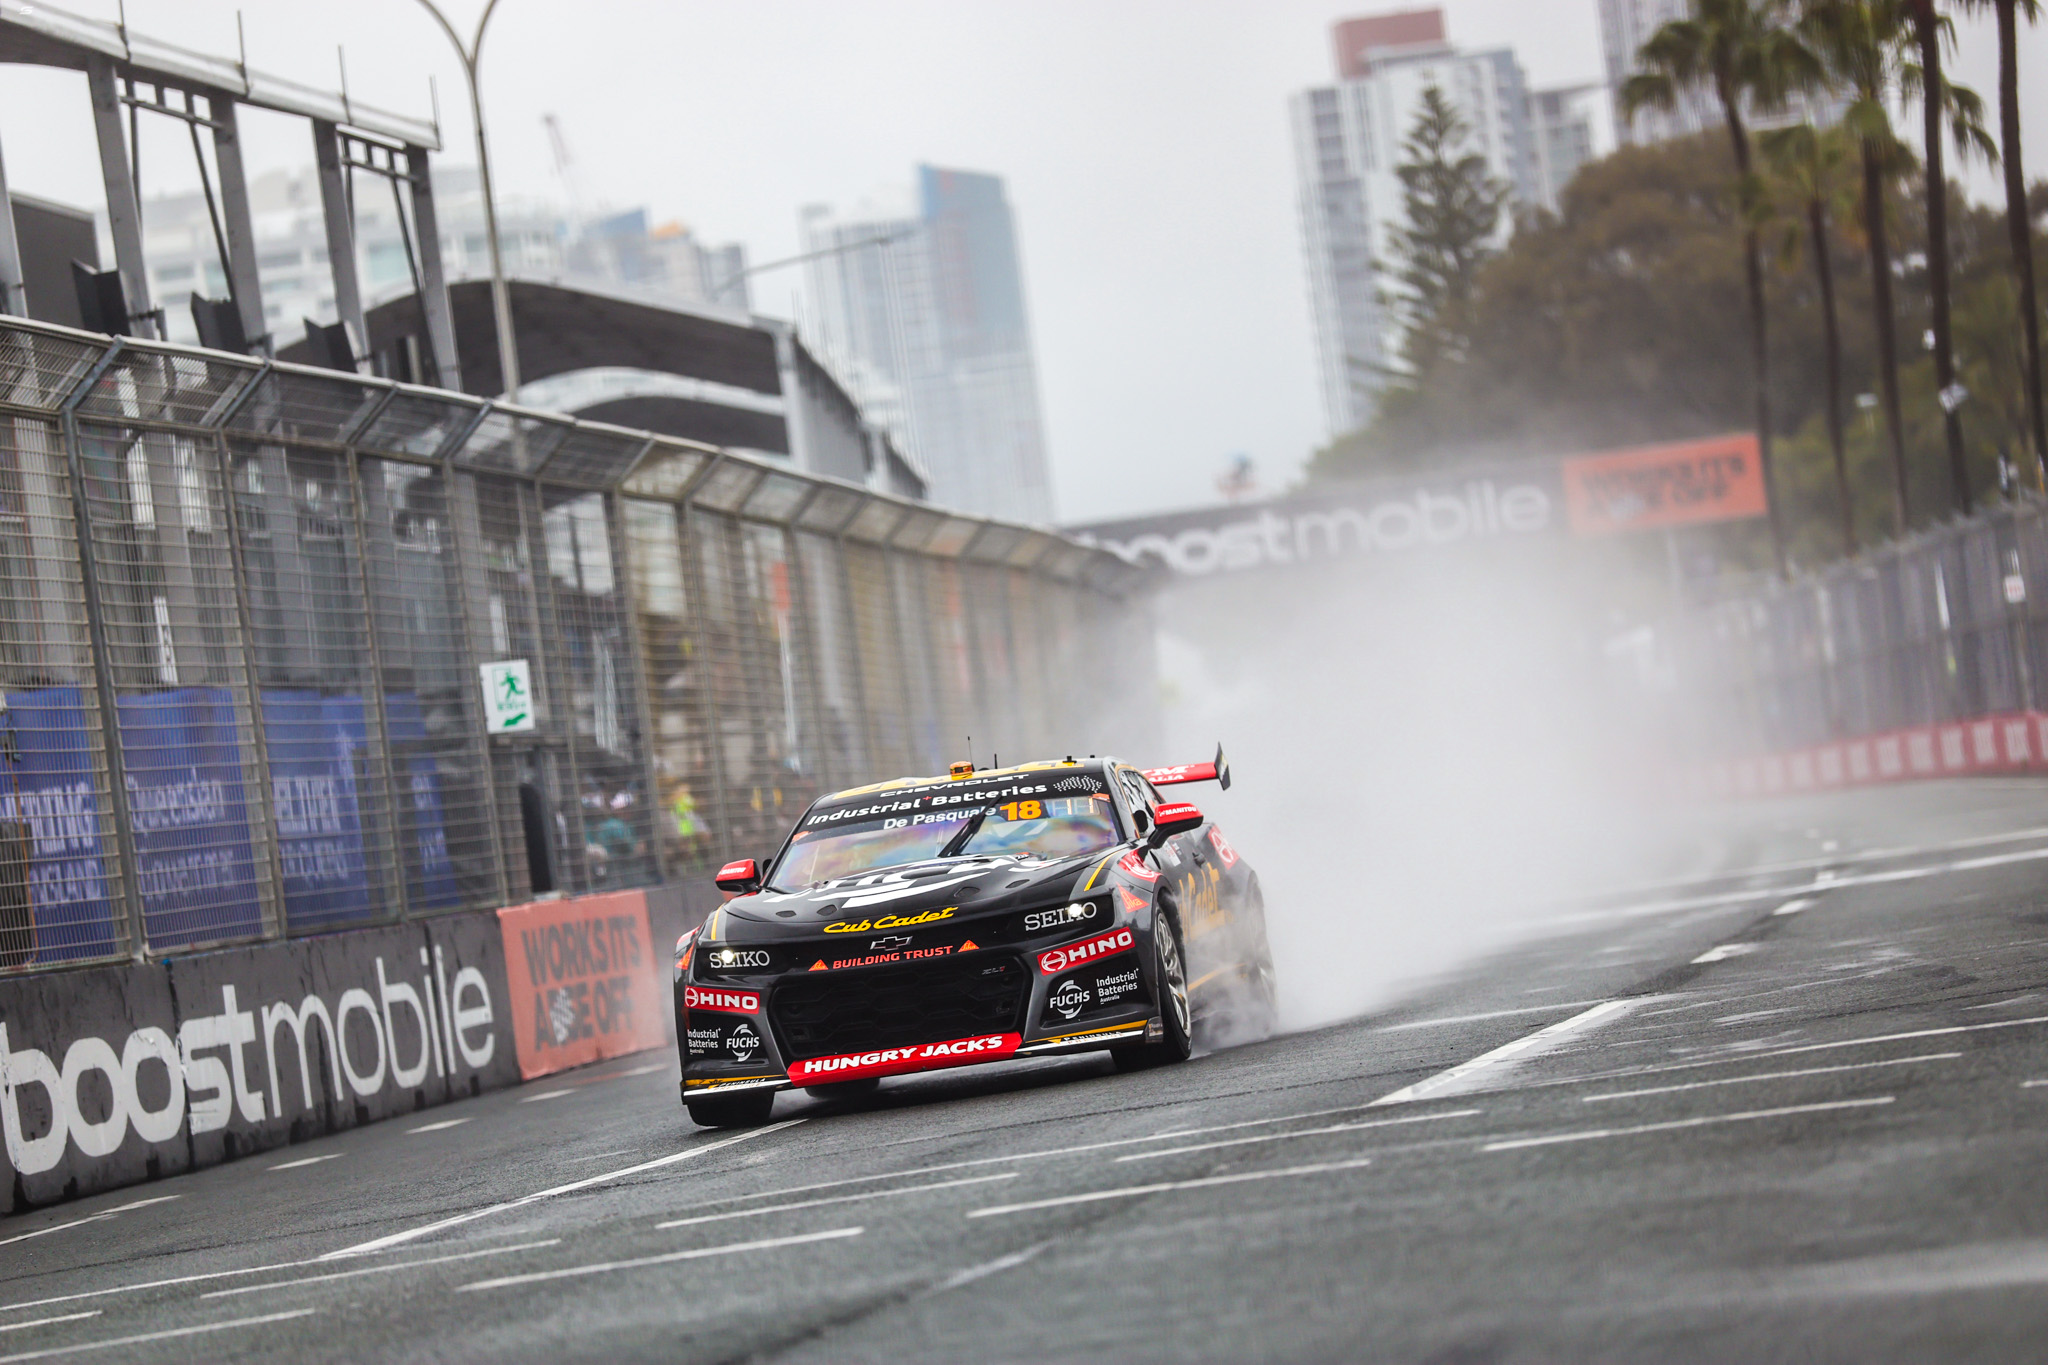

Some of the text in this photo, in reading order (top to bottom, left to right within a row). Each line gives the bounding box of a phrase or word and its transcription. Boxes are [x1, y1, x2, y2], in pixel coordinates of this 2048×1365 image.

[879, 774, 1029, 798] CHEVROLET
[807, 796, 923, 826] Industrial
[931, 783, 1047, 807] Batteries
[1000, 800, 1042, 821] 18
[883, 816, 907, 830] De
[823, 907, 959, 933] Cub Cadet
[522, 918, 608, 987] WORKS
[832, 945, 953, 969] BUILDING TRUST
[1068, 931, 1133, 962] HINO
[1096, 971, 1137, 988] Industrial
[1098, 982, 1138, 997] Batteries
[594, 976, 633, 1035] OFF
[700, 992, 759, 1010] HINO
[1050, 990, 1090, 1009] FUCHS
[687, 1028, 719, 1039] Industrial
[688, 1039, 719, 1049] Batteries
[726, 1036, 760, 1049] FUCHS
[0, 945, 495, 1175] boostmobile
[804, 1035, 1003, 1073] HUNGRY JACK'S
